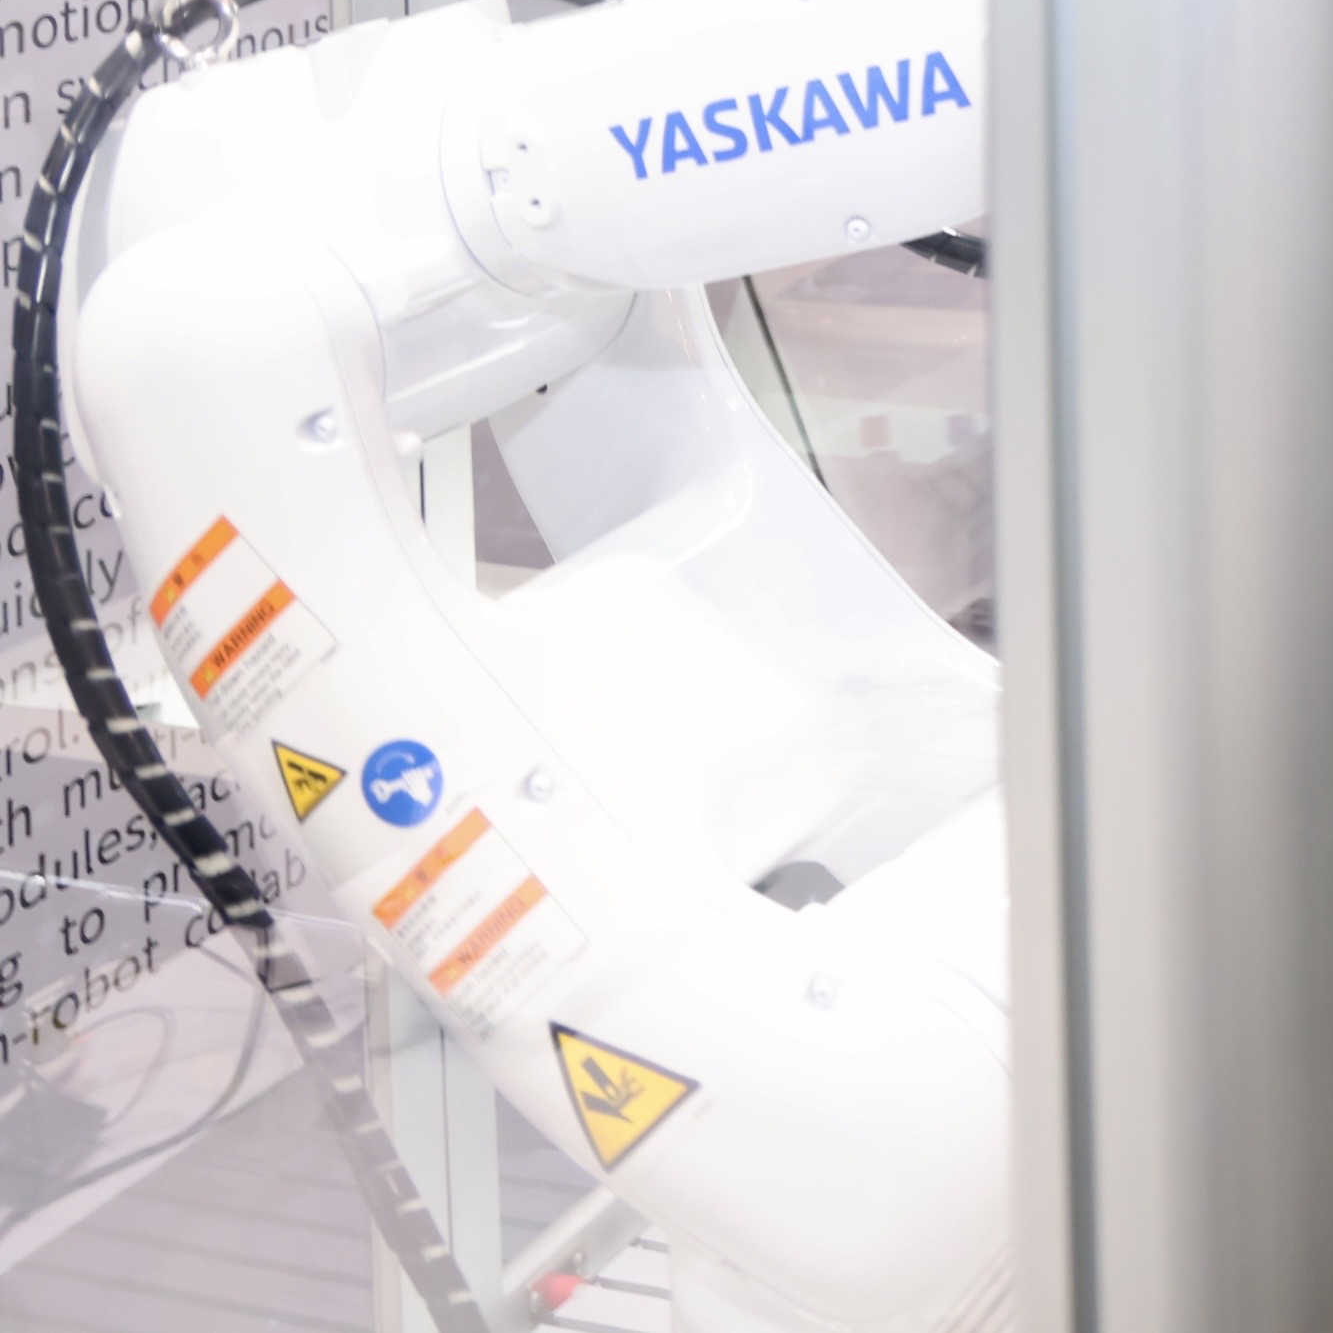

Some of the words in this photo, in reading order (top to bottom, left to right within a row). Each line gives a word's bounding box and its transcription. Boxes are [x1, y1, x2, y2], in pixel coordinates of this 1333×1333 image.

[609, 50, 973, 181] YASKAWA
[210, 600, 276, 668] WARNING
[60, 907, 105, 956] to
